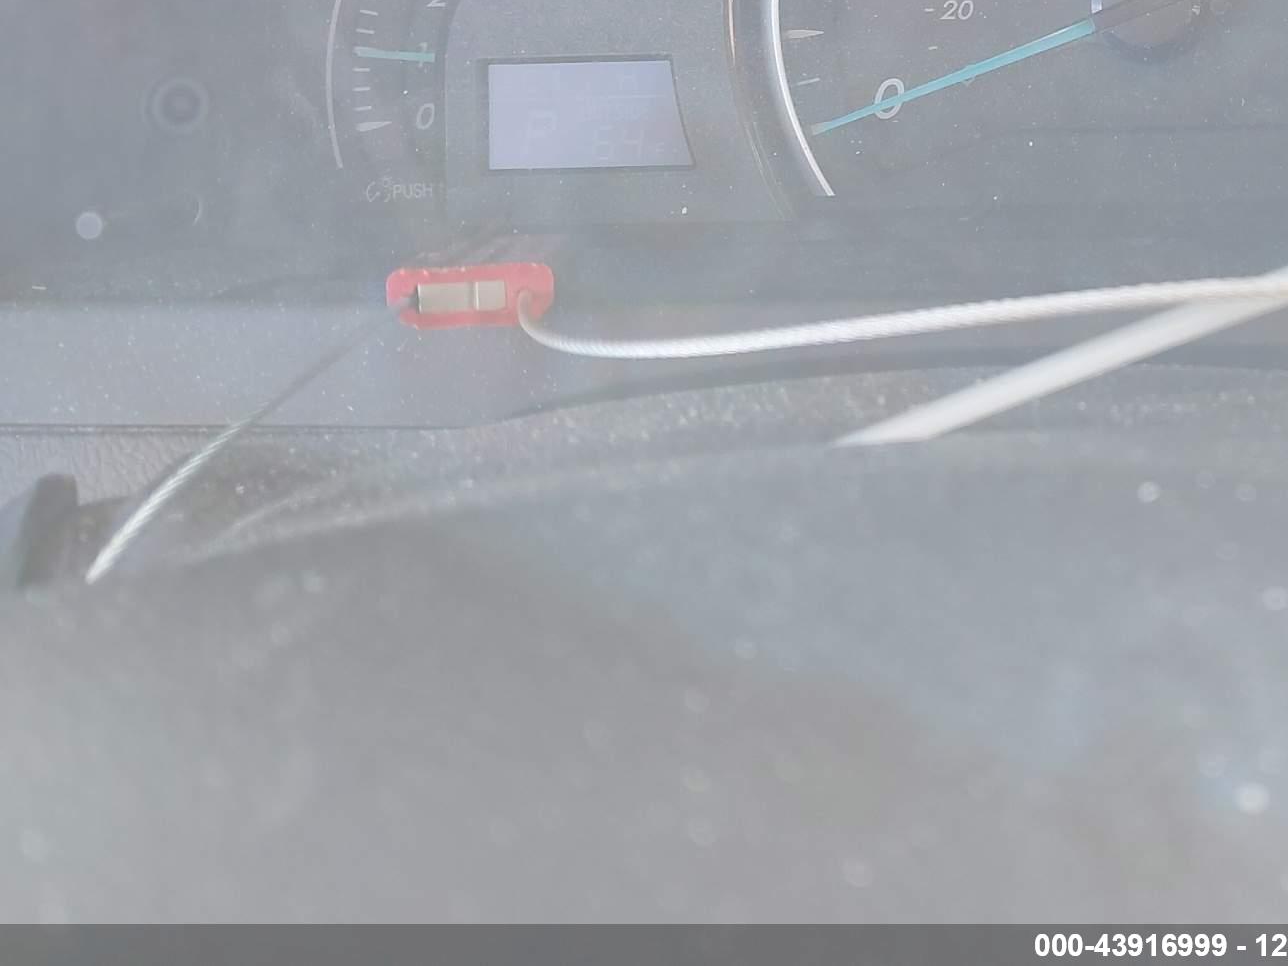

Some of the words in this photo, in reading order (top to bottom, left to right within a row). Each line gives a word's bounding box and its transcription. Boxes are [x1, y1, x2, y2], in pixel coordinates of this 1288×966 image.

[940, 0, 974, 21] 20
[873, 77, 906, 121] 0
[416, 103, 435, 130] 0
[393, 183, 433, 199] PUSH
